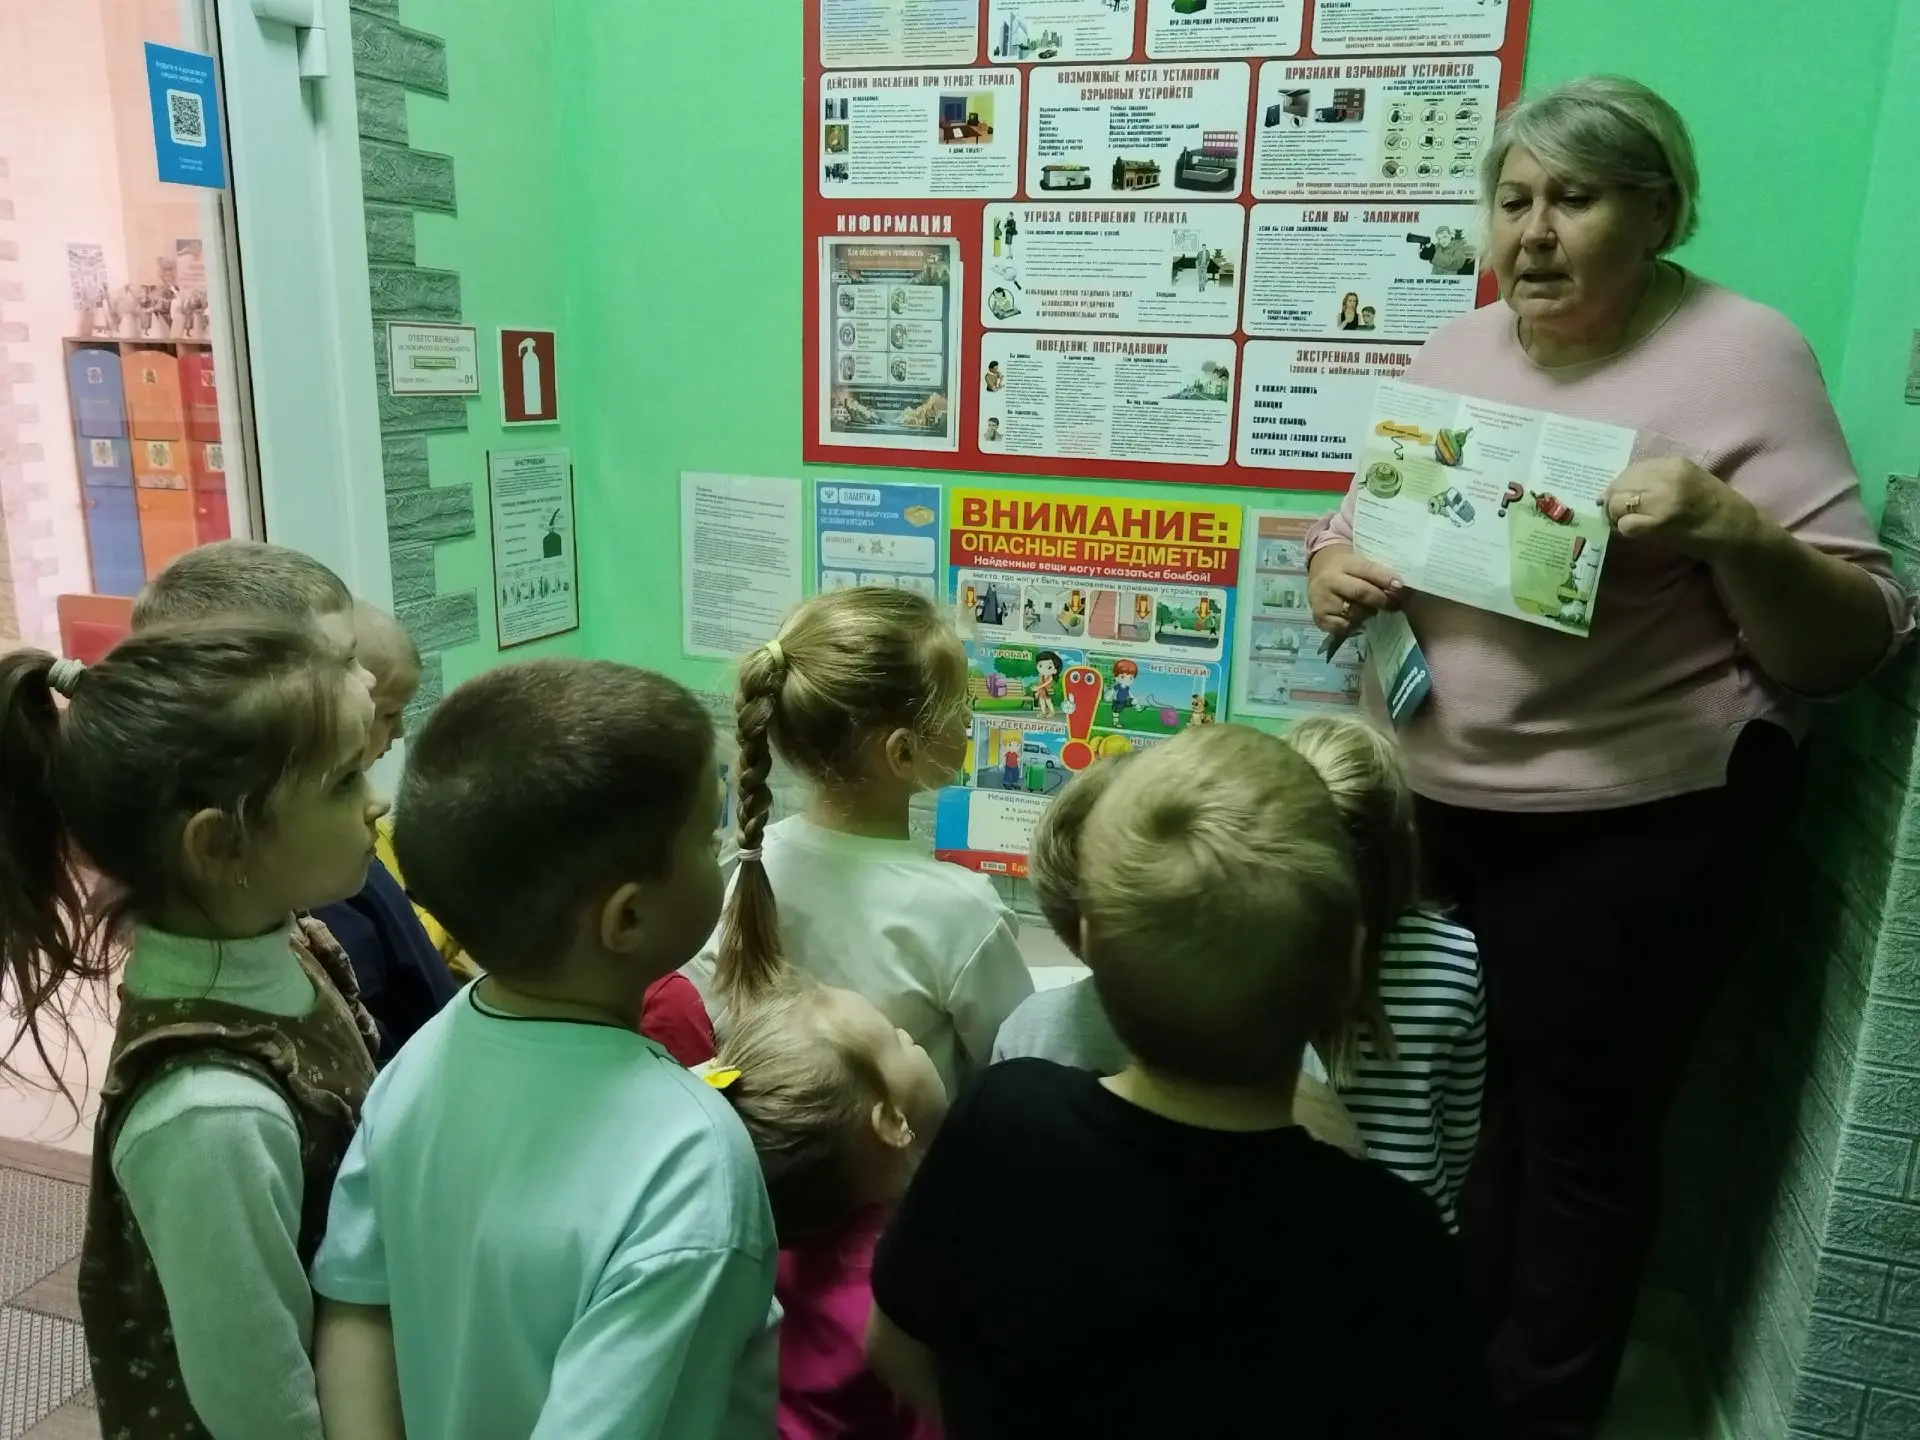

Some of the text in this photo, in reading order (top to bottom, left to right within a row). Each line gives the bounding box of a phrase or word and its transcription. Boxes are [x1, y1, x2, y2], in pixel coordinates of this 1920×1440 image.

[1058, 68, 1220, 84] ВОЗМОЖНЫЕ МЕСТА УСТАНОВКИ
[1285, 62, 1474, 80] ПРИЗНАКИ ВЗРЫВНЫХ УСТРОЙСТВ
[826, 74, 1015, 90] ДЕЙСТВИЯ НАСЕЛЕНИЯ ПРИ УГРОЗЕ ТЕРАКТА
[1080, 86, 1194, 101] ВЗРЫВНЫХ УСТРОЙСТВ
[1024, 211, 1188, 224] УГРОЗА СОВЕРШЕНИЯ ТЕРАКТА
[1302, 210, 1328, 223] ЕСЛИ
[1333, 211, 1348, 222] ВЫ
[1362, 211, 1420, 224] ЗАЛОЖНИК
[837, 214, 952, 235] ИНФОРМАЦИЯ
[848, 248, 858, 256] Как
[408, 334, 460, 343] ОТВЕТСТВЕННЫЙ
[1036, 340, 1168, 356] ПОВЕДЕНИЕ ПОСТРАДАВШИХ
[1296, 350, 1412, 366] ЭКСТРЕННАЯ ПОМОЩЬ
[1329, 366, 1370, 376] мобильных
[464, 374, 474, 384] 01
[1262, 385, 1286, 393] ПОЖАРЕ
[1290, 386, 1318, 394] ЗВОНИТЬ
[1254, 400, 1282, 409] ПОЛИЦИЯ
[1253, 416, 1306, 426] СКОРАЯ ПОМОЩЬ
[1252, 431, 1346, 443] АВАРИЙНАЯ ГАЗОВАЯ СЛУЖБА
[1279, 449, 1318, 458] ЭКСТРЕННЫХ
[844, 492, 876, 502] ПАМЯТКА
[962, 498, 1228, 544] ВНИМАНИЕ:
[961, 534, 1227, 570] ОПАСНЫЕ ПРЕДМЕТЫ!
[974, 556, 1210, 582] Найденные вещи могут оказаться бомбой!
[973, 572, 999, 581] Места,
[1016, 576, 1039, 584] могут
[1041, 576, 1059, 585] быть
[1061, 579, 1116, 590] установлены
[1118, 583, 1158, 593] взрывные
[993, 649, 1032, 660] ТРОГАЙ!
[1166, 666, 1210, 676] ТОЛКАЙ!
[986, 719, 1066, 734] НЕ ПЕРЕДВИГАЙ!
[988, 793, 1041, 806] Немедленно
